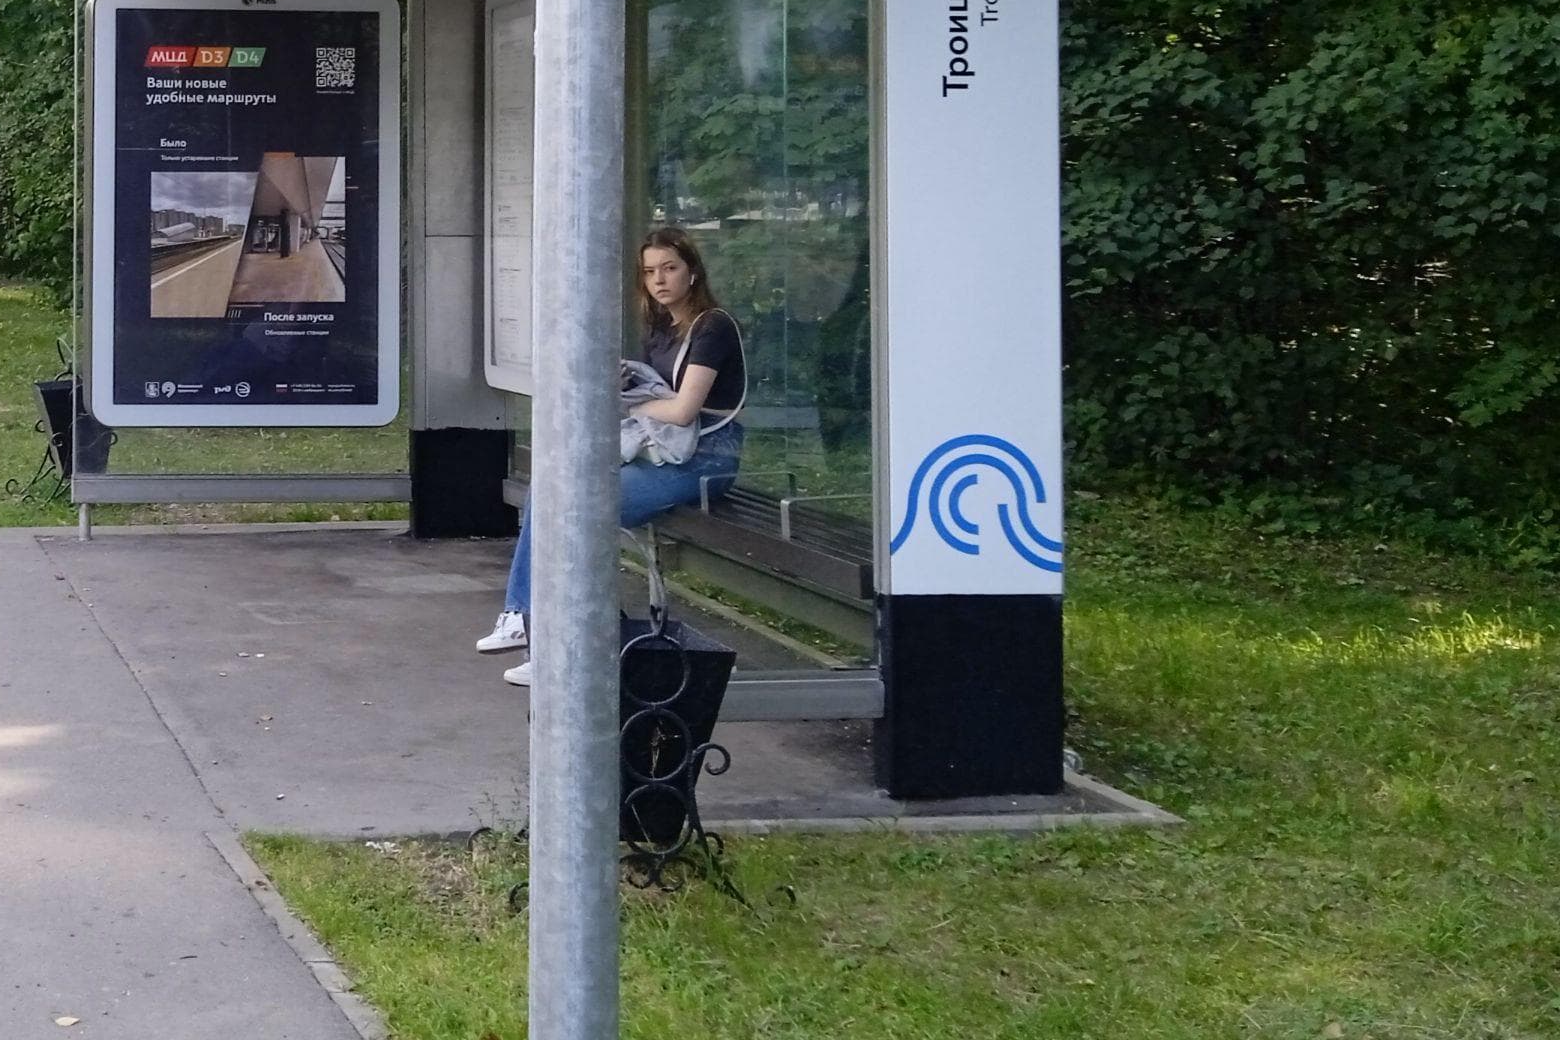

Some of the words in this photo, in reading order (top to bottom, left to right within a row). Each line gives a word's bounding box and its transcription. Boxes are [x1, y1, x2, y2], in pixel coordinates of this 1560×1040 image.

[151, 51, 188, 63] МЦД
[200, 50, 224, 64] D3
[236, 51, 260, 64] D4
[147, 77, 182, 89] Ваши
[185, 79, 227, 89] новые
[146, 92, 204, 105] удобные
[207, 94, 276, 105] маршруты
[160, 138, 187, 148] Было
[264, 312, 295, 321] После
[297, 313, 334, 323] запуска
